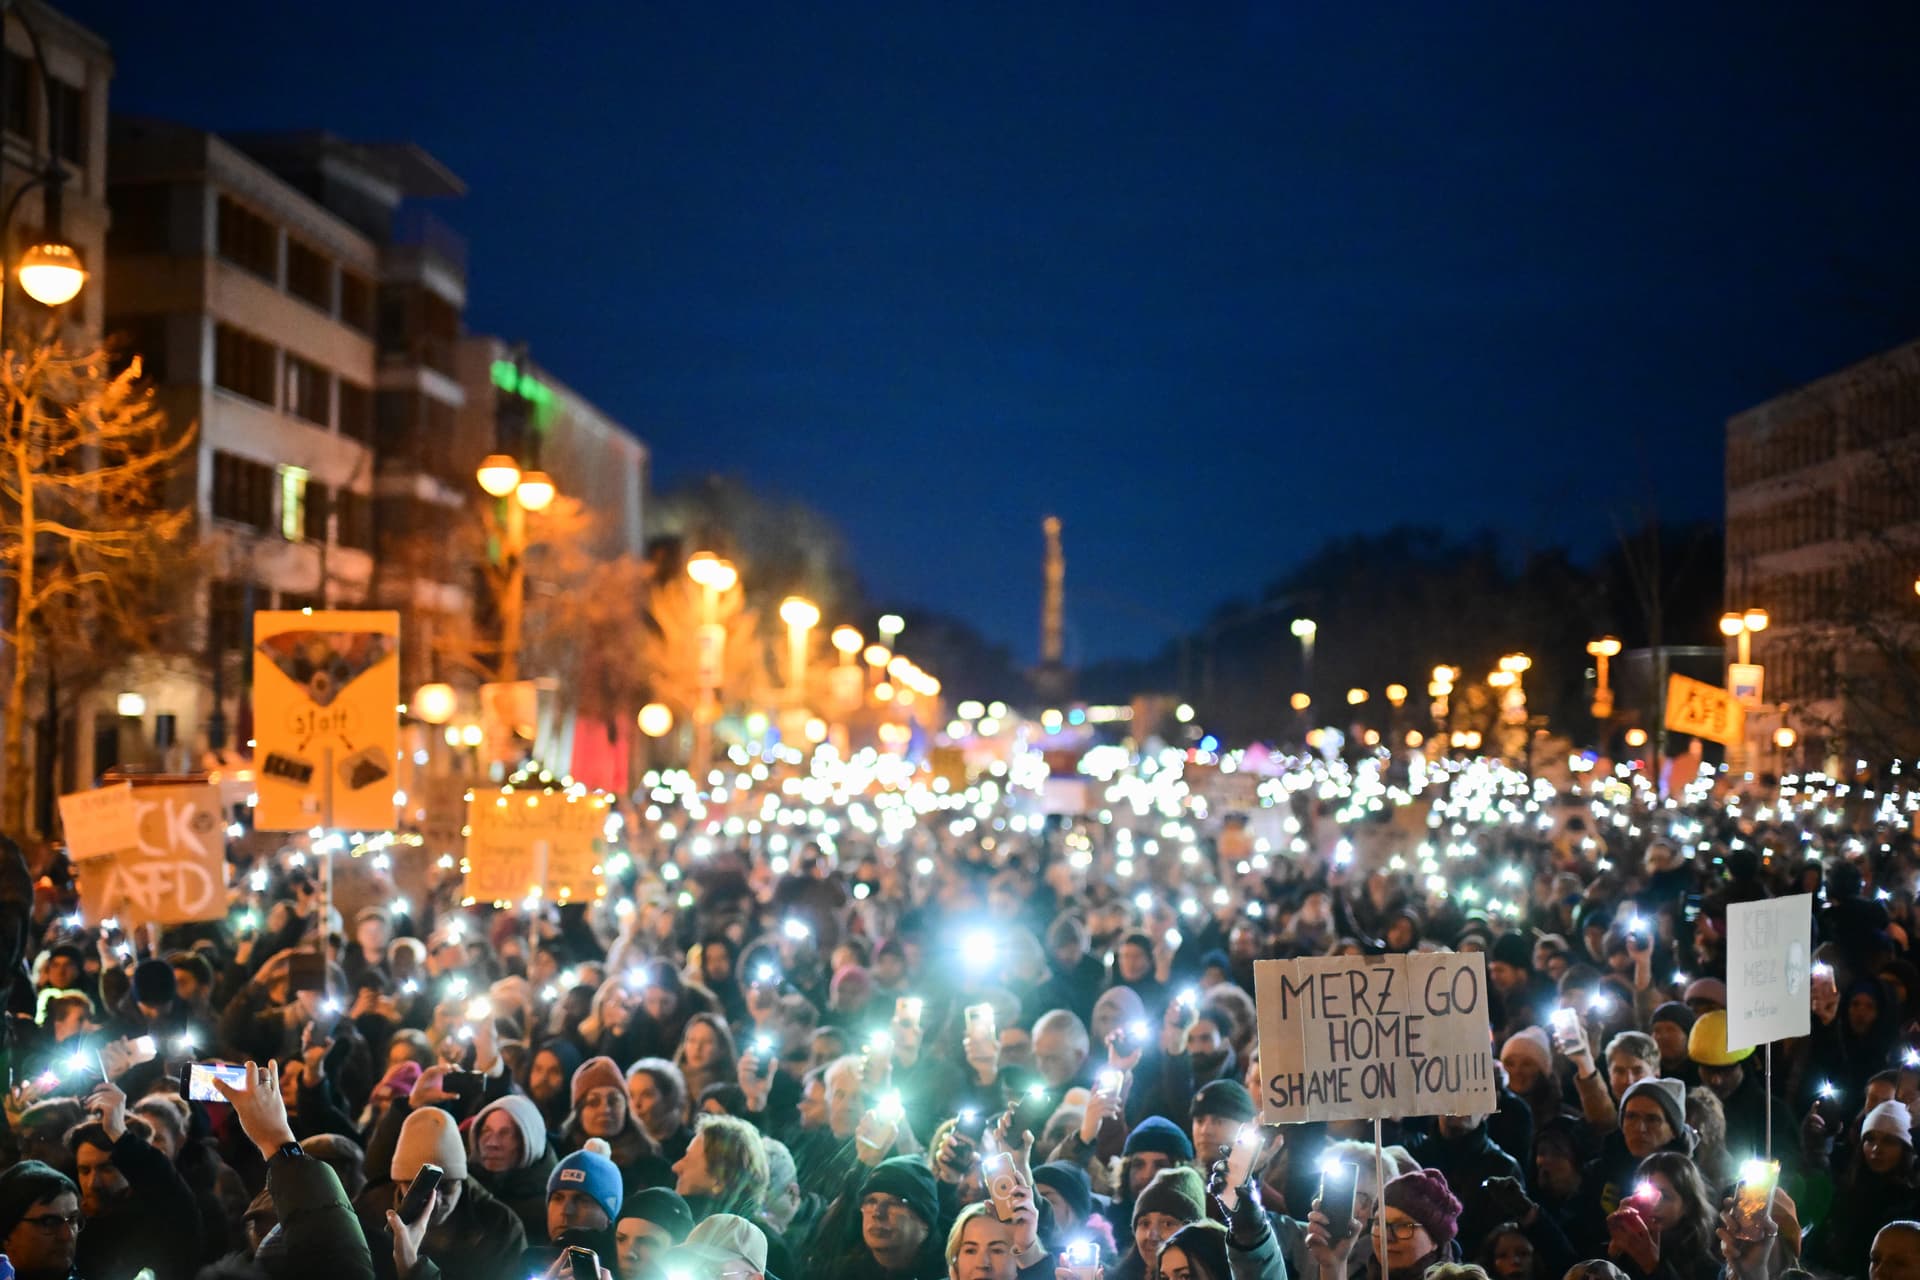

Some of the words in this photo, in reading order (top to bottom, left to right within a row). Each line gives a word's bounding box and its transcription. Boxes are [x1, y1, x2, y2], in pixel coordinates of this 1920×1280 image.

[101, 861, 215, 916] AFD
[1281, 968, 1400, 1020] MERZ
[1425, 966, 1478, 1016] GO
[1328, 1015, 1425, 1062] HOME
[1269, 1067, 1352, 1108] SHAME
[1361, 1062, 1396, 1099] ON
[1410, 1052, 1488, 1095] YOU!!!
